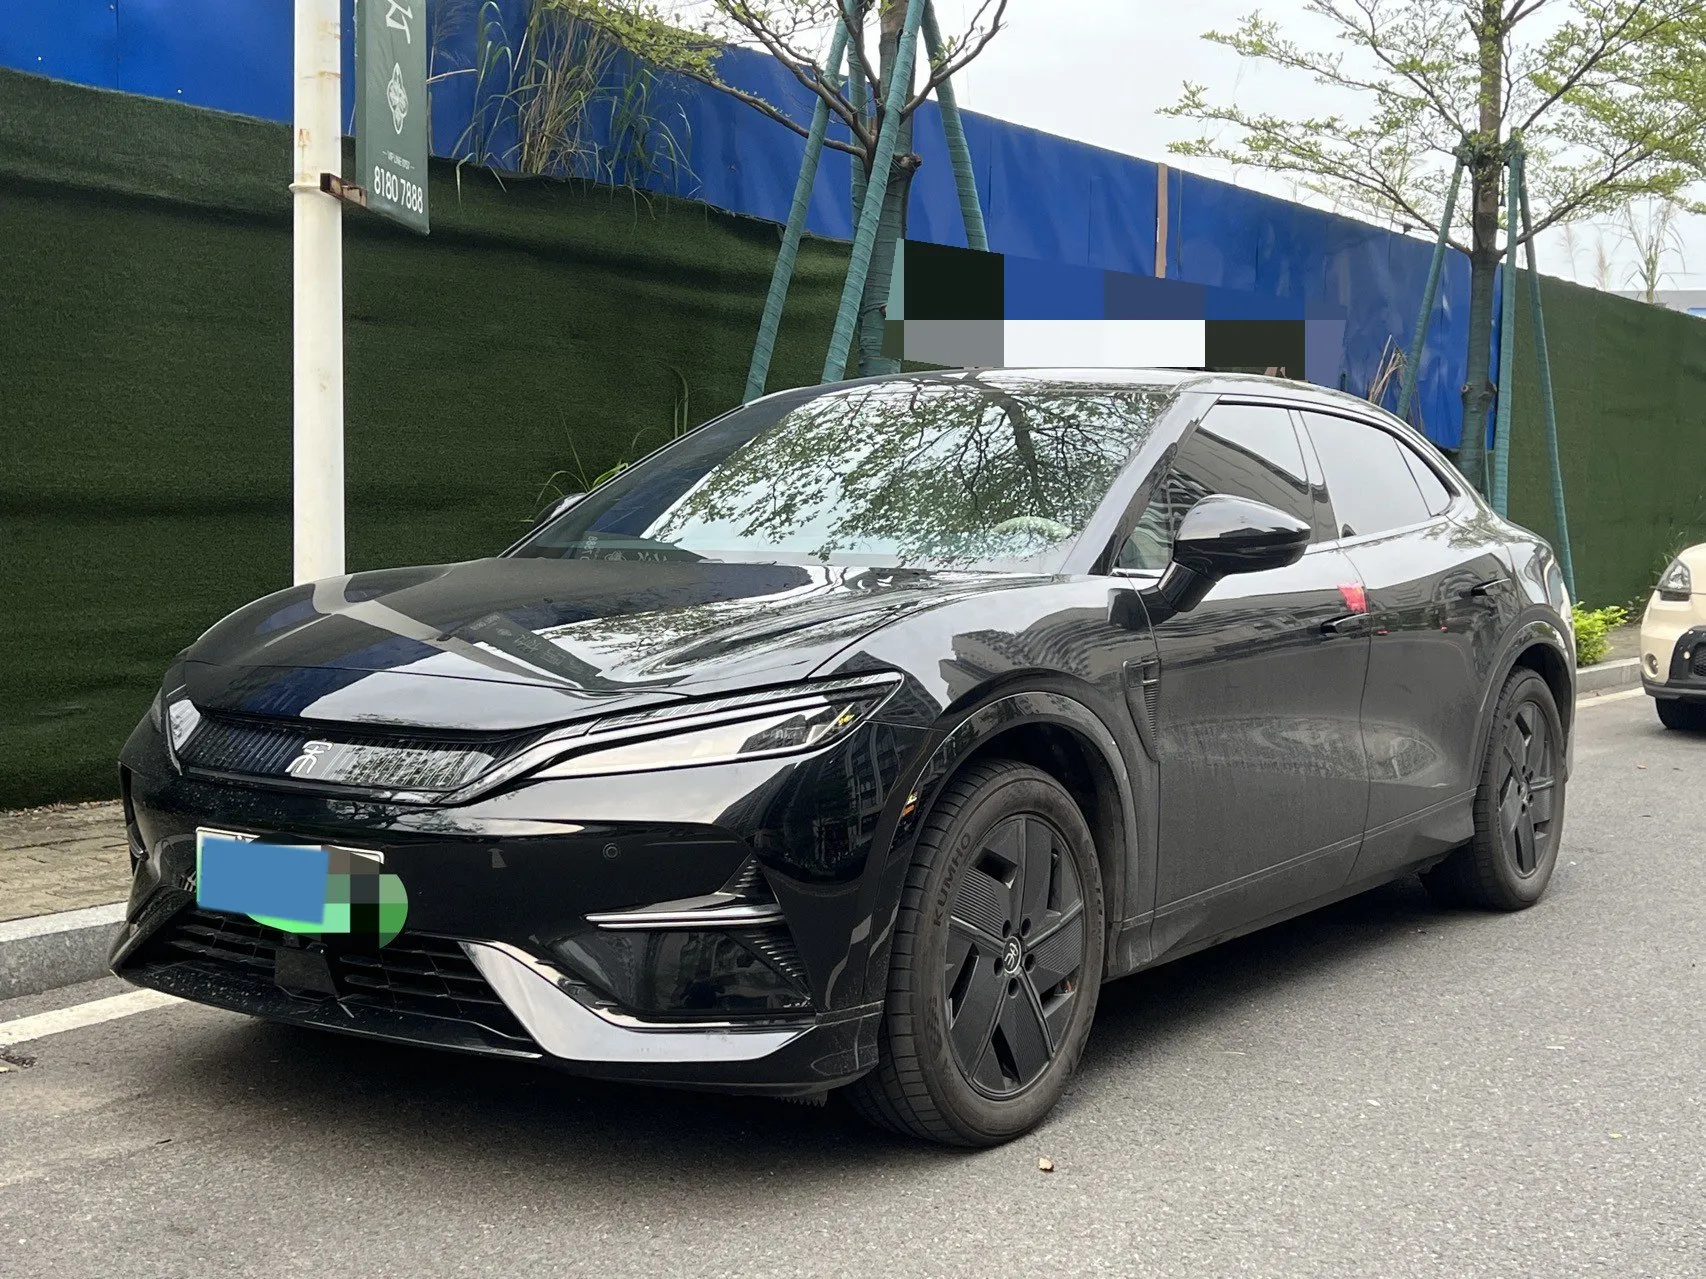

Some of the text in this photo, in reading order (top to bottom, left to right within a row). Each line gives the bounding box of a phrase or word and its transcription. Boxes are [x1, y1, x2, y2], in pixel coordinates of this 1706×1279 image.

[374, 165, 423, 213] 8180 7888
[933, 832, 971, 927] KUMHO
